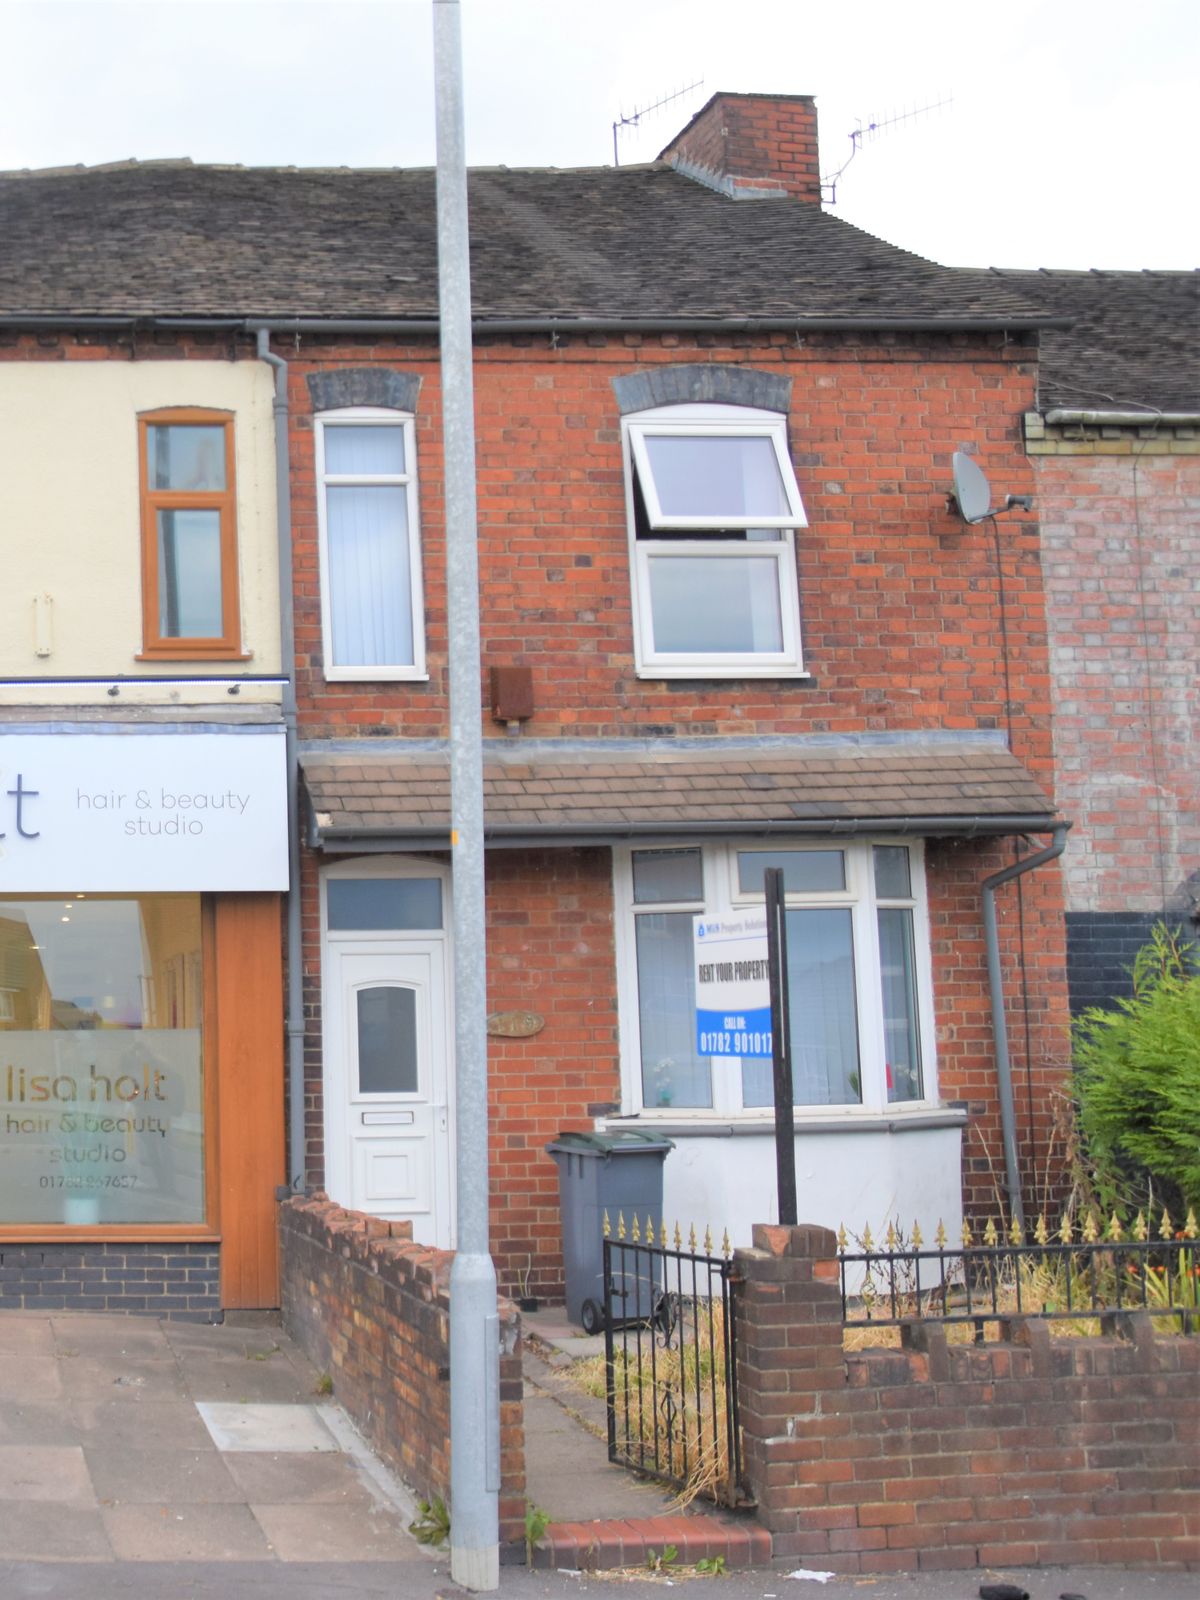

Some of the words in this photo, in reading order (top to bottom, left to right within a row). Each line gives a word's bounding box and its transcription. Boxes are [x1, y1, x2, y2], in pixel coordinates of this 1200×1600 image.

[76, 786, 128, 810] hair
[134, 789, 153, 810] &
[161, 786, 251, 816] beauty
[123, 813, 205, 836] studio
[698, 962, 715, 984] RENT
[715, 961, 733, 983] YOUR
[700, 1031, 731, 1053] 01782
[734, 1031, 772, 1054] 901017
[6, 1064, 77, 1103] lisa
[89, 1062, 167, 1102] holt
[6, 1113, 50, 1134] hair
[58, 1113, 77, 1133] &
[83, 1113, 169, 1138] beauty
[49, 1144, 127, 1164] studio
